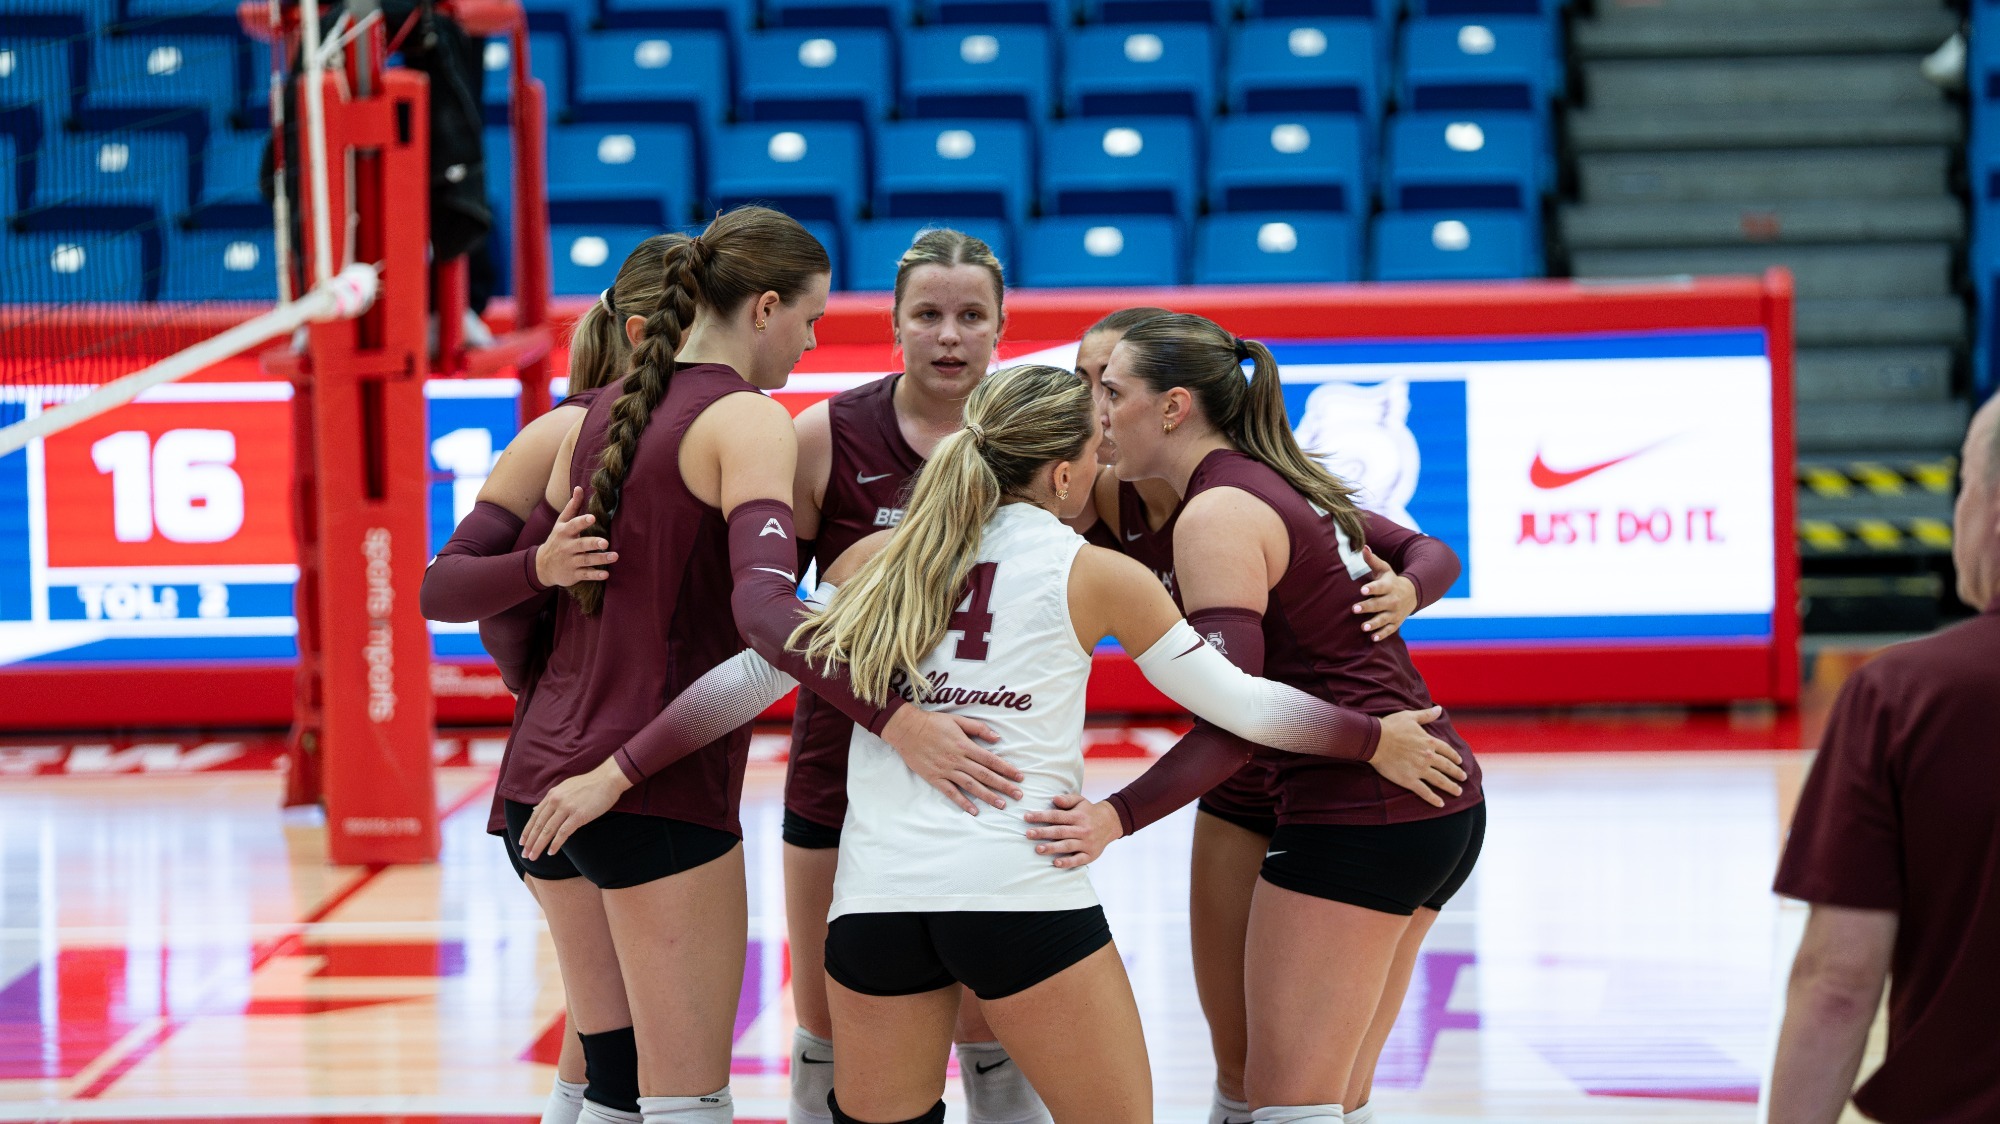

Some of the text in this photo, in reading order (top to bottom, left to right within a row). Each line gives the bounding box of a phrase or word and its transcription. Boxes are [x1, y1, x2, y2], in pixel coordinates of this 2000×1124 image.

[91, 428, 245, 544] 16
[430, 427, 504, 532] 1
[1515, 510, 1600, 545] JUST
[1617, 508, 1673, 544] DO
[362, 527, 395, 618] sports
[946, 560, 1000, 664] 4
